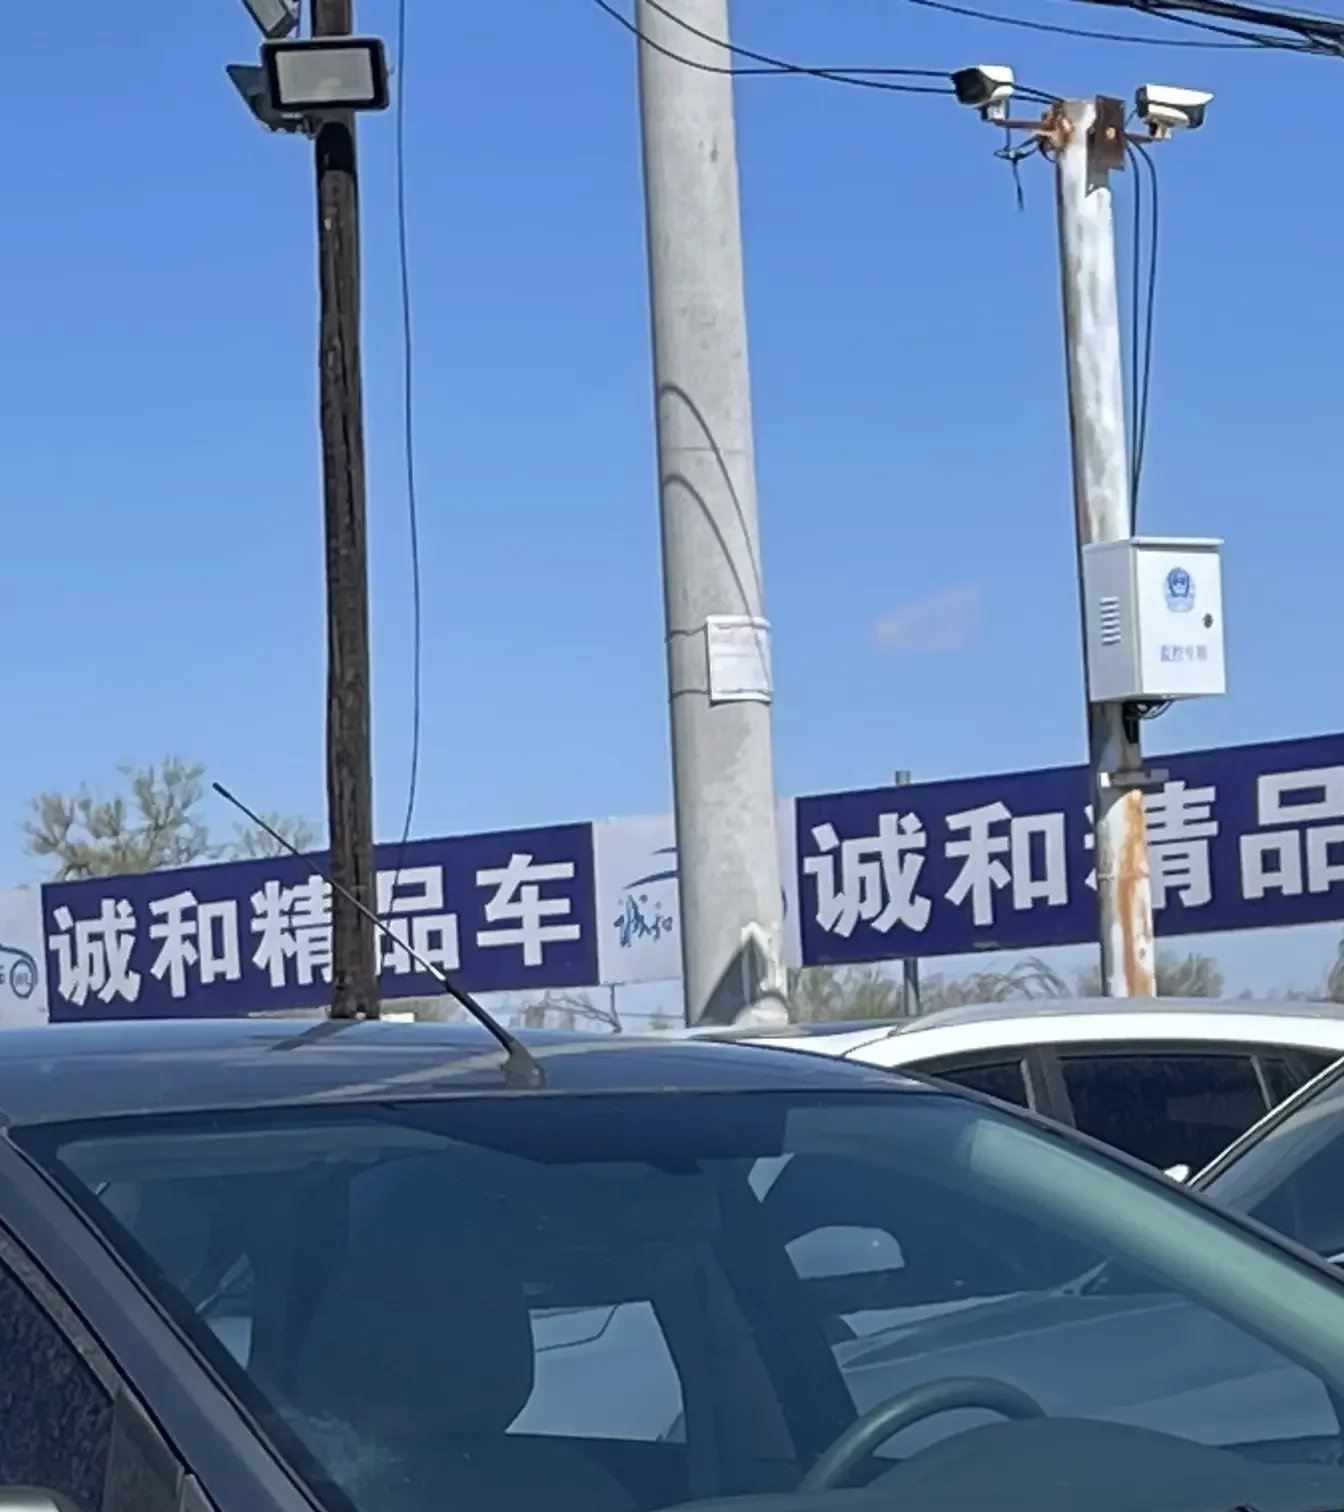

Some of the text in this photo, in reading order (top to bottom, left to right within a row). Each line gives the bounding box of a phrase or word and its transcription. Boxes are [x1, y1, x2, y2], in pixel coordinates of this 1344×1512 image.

[49, 854, 580, 1007] 诚和精品车
